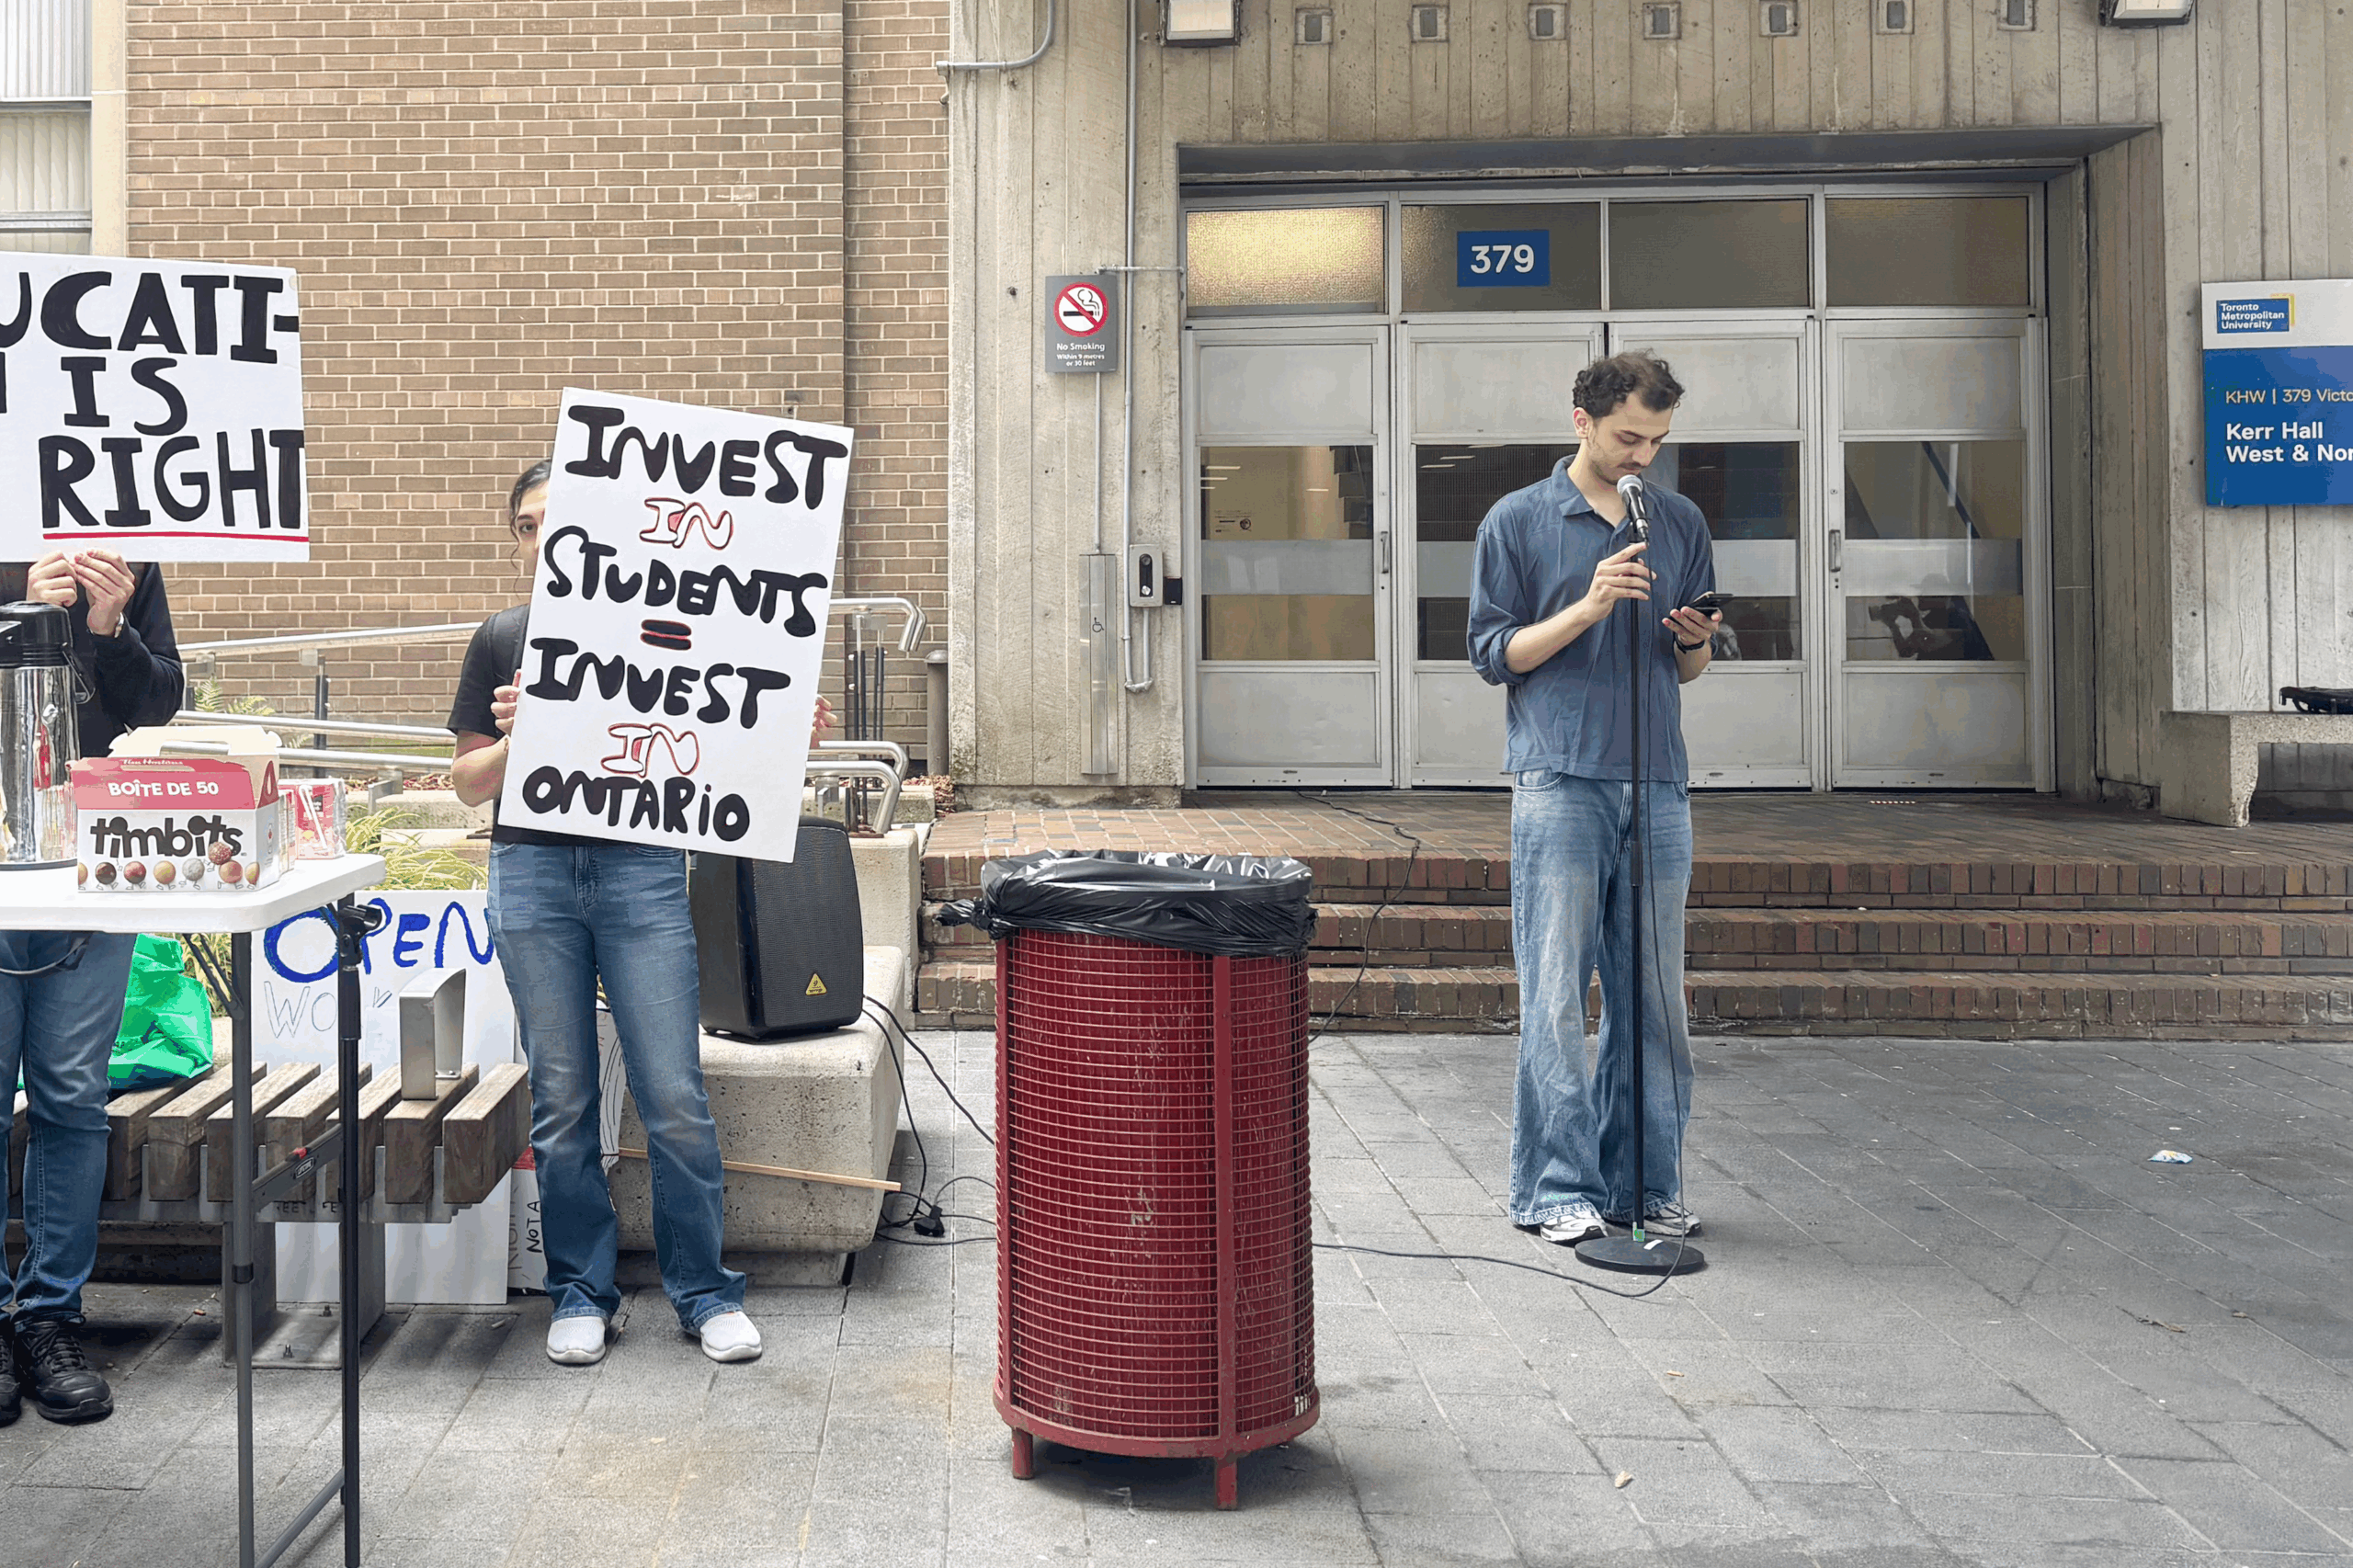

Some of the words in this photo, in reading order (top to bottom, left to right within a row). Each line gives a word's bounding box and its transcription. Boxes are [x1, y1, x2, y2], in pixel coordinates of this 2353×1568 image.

[1471, 244, 1534, 274] 379
[2221, 302, 2259, 312] Toronto
[2221, 311, 2285, 322] Metropolitan
[2221, 320, 2273, 330] University
[1070, 343, 1105, 352] Smoking
[61, 357, 188, 436] IS
[2225, 390, 2266, 404] KHW
[2282, 389, 2312, 403] 379
[2226, 423, 2274, 441] Kerr
[2281, 421, 2324, 439] Hall
[565, 404, 848, 509] INVEST
[2225, 445, 2284, 463] West
[2291, 444, 2309, 461] &
[39, 428, 304, 528] RIGHT
[640, 497, 733, 551] IN
[544, 525, 828, 637] STUDENTS
[525, 637, 791, 729] INVEST
[600, 722, 700, 778] IN
[108, 779, 164, 797] BOÎTE
[167, 782, 192, 796] DE
[196, 781, 219, 795] 50
[90, 814, 244, 858] timbits
[264, 897, 494, 983] OPEN
[527, 1200, 540, 1212] A
